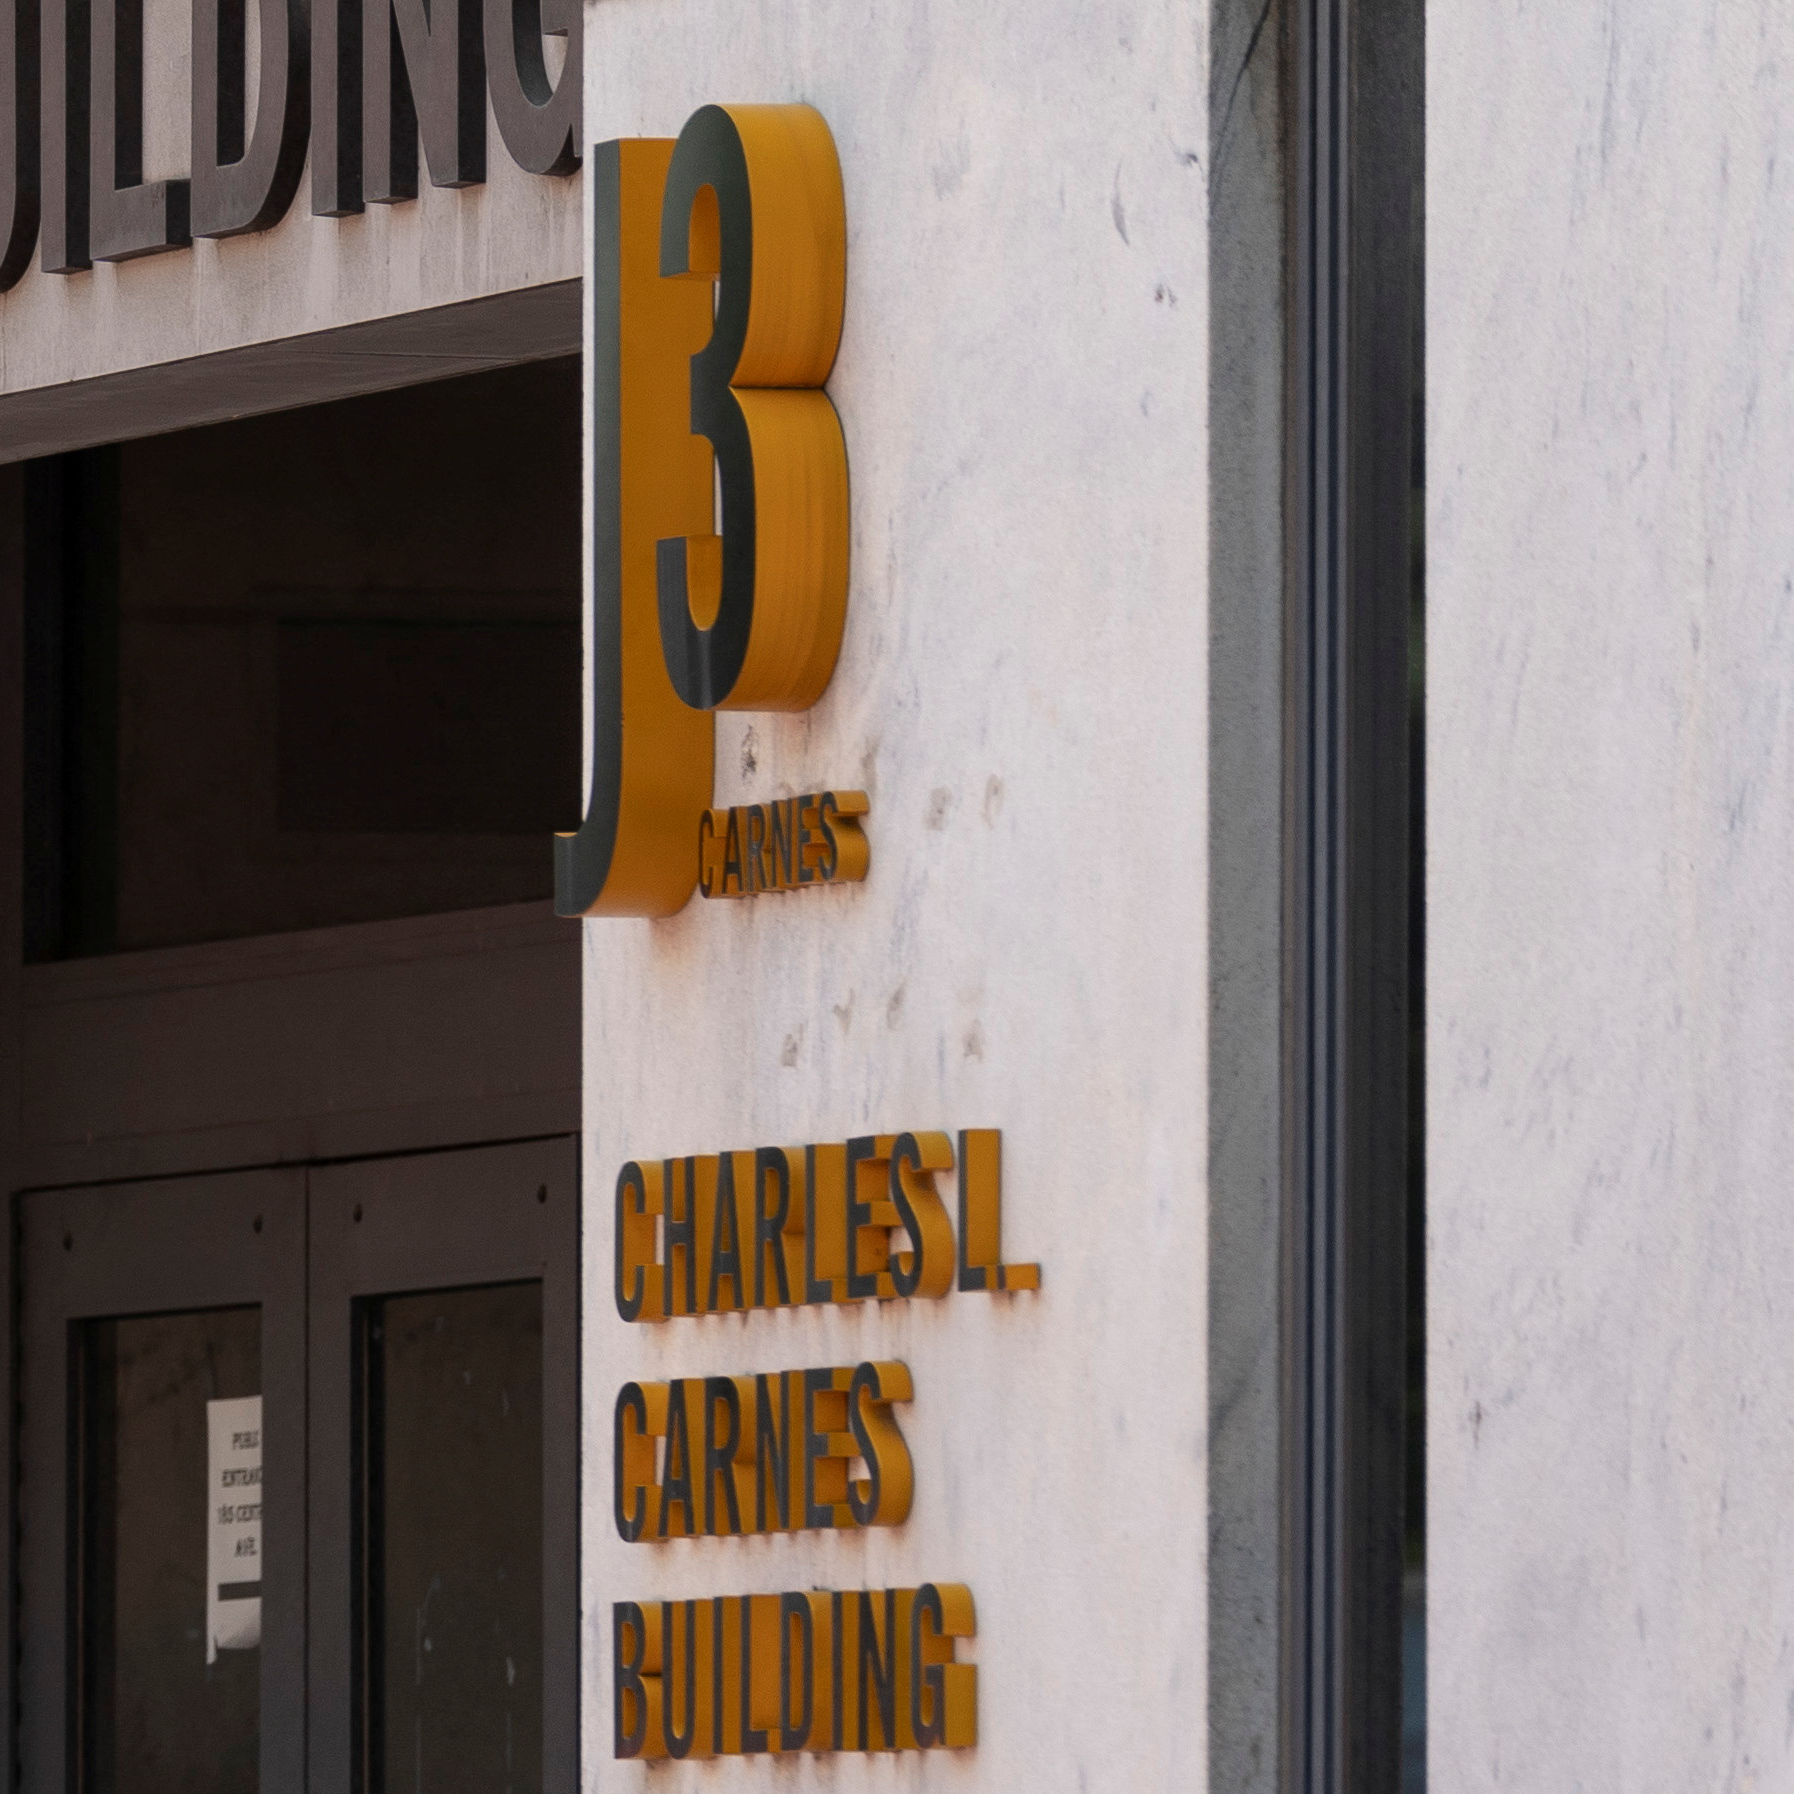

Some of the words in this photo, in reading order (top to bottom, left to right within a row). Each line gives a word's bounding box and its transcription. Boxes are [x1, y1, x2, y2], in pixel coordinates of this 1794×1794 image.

[697, 790, 870, 898] CARNES
[615, 1131, 953, 1323] CHARLES
[614, 1361, 914, 1543] CARNES
[613, 1582, 977, 1760] BUILDING
